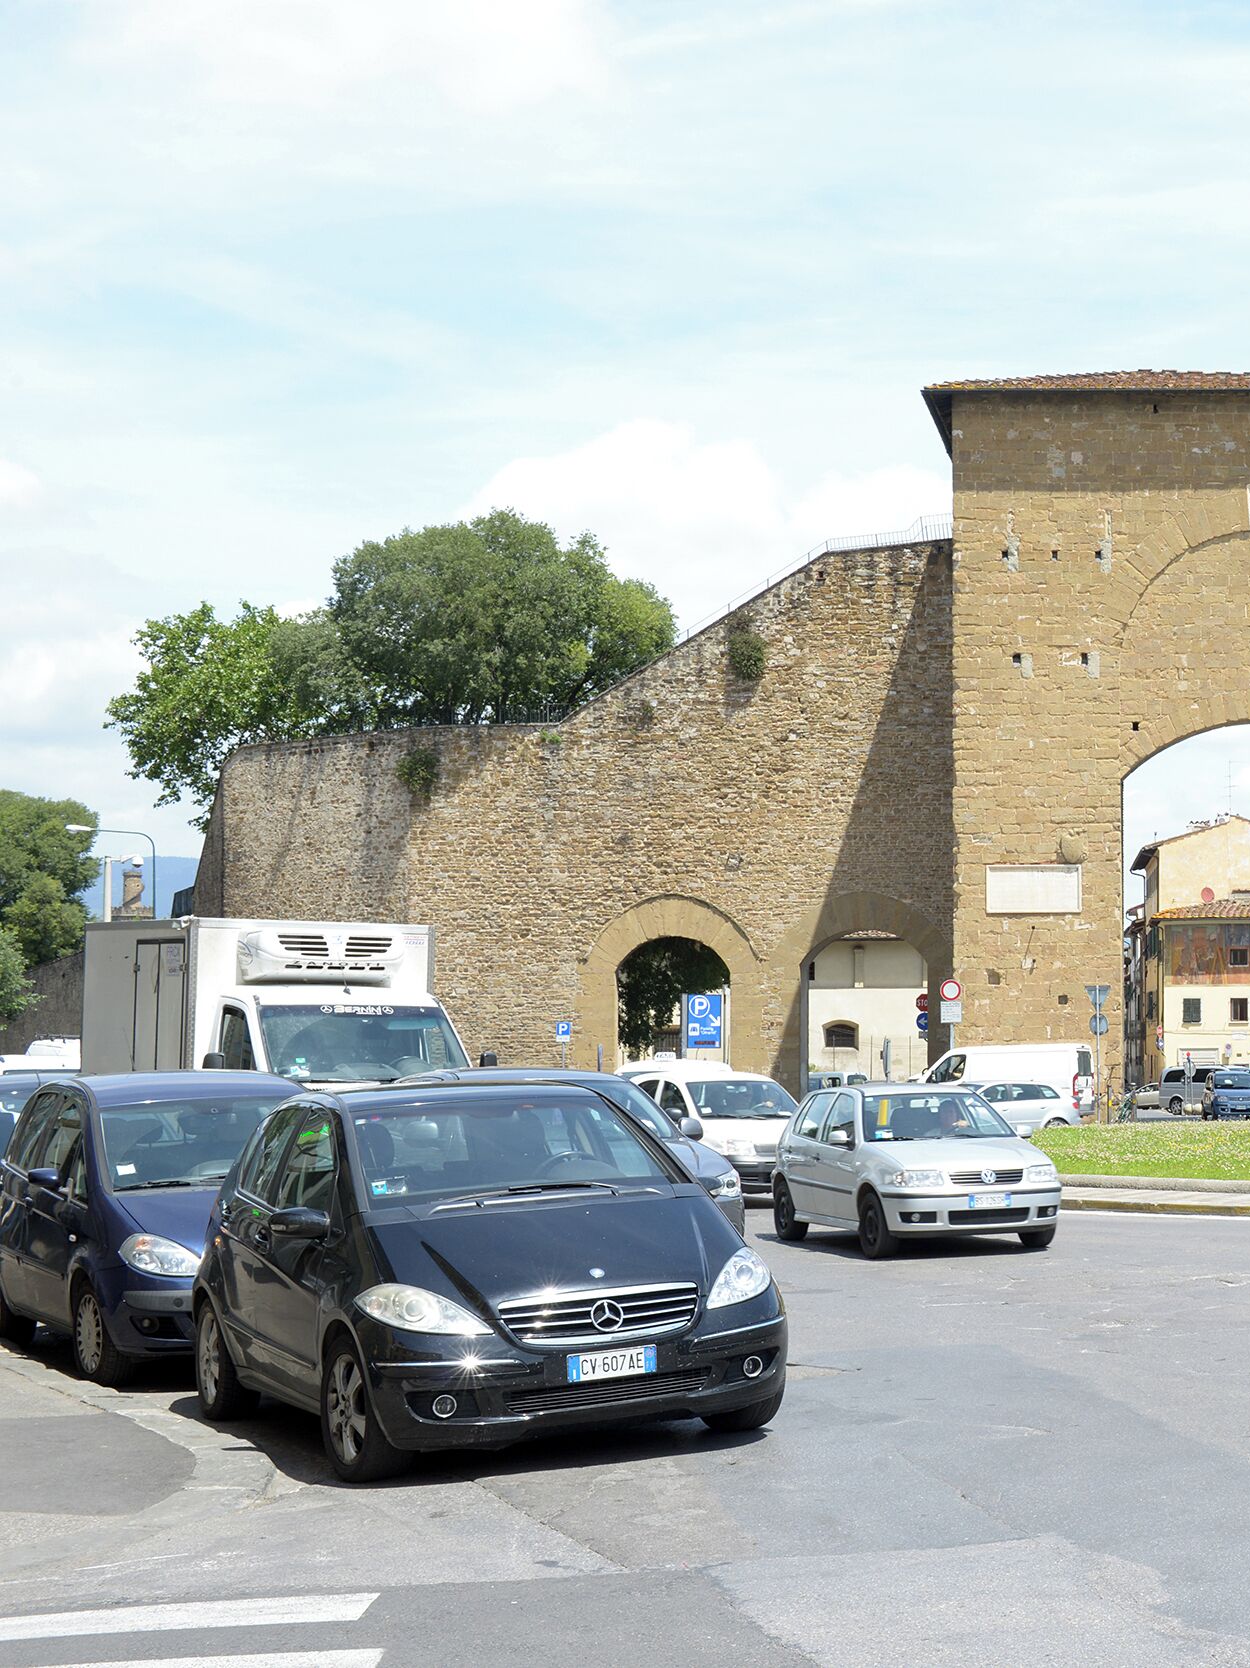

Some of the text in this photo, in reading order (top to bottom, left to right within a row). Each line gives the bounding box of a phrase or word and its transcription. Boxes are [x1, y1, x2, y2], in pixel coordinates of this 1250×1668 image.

[694, 998, 707, 1015] P
[916, 999, 928, 1007] STO
[558, 1023, 569, 1035] P
[581, 1352, 644, 1376] CV 607AE
